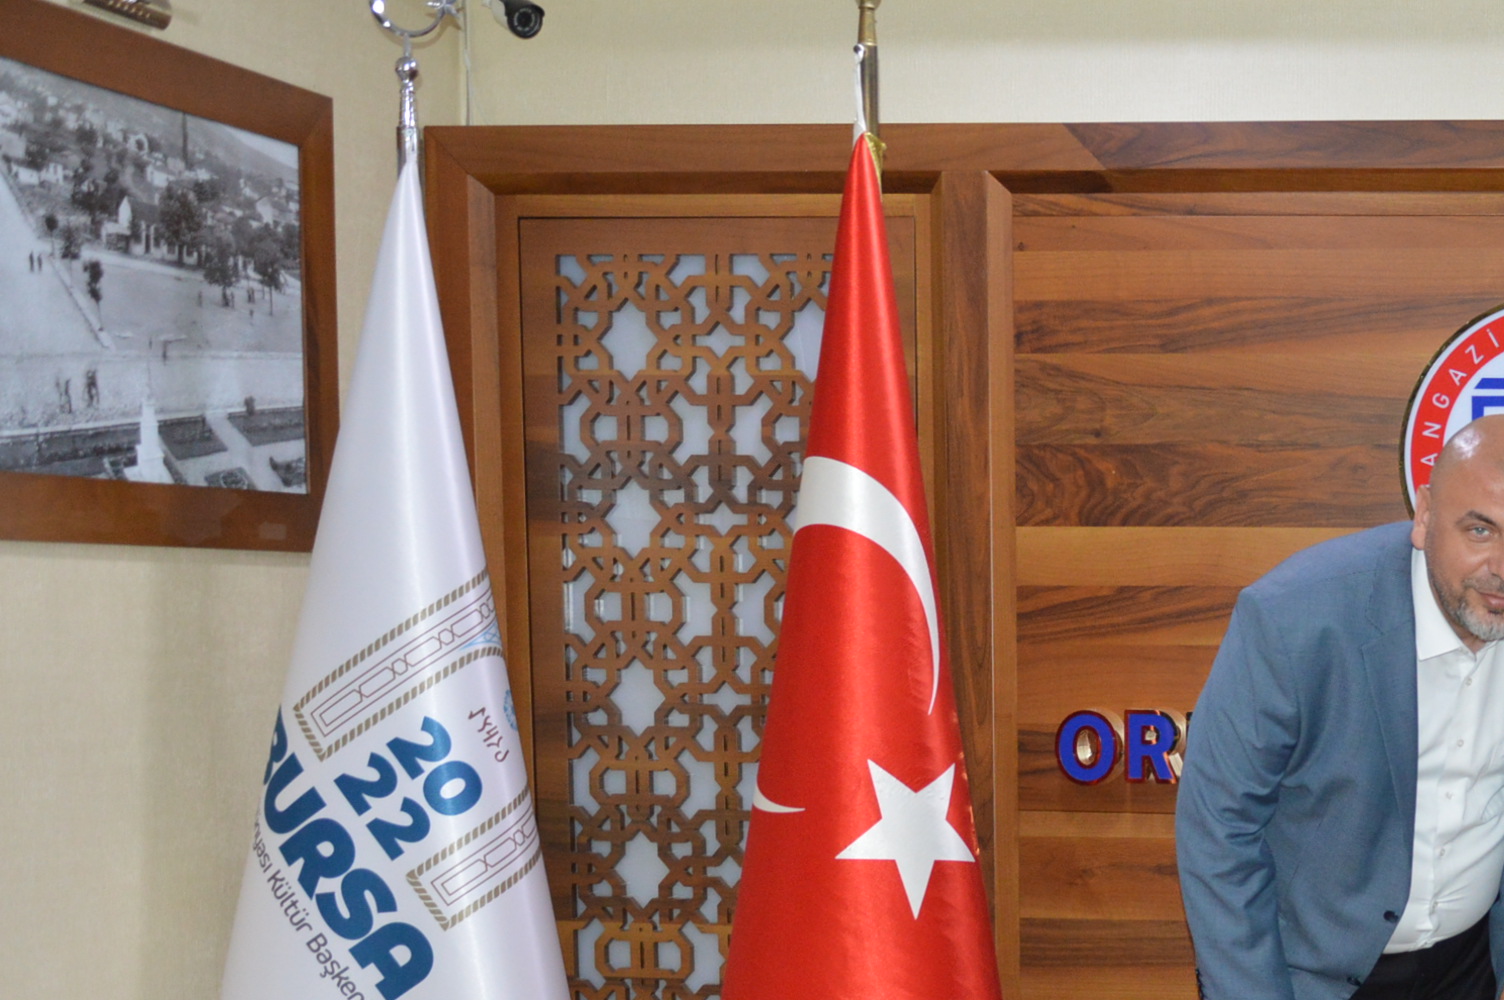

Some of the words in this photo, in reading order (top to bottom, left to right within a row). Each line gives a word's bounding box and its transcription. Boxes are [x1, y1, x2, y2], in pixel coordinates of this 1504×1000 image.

[1420, 327, 1500, 488] ANGAZİ
[386, 716, 483, 816] 20
[1054, 709, 1192, 786] OR
[333, 752, 431, 861] 22
[267, 869, 312, 932] Kültür
